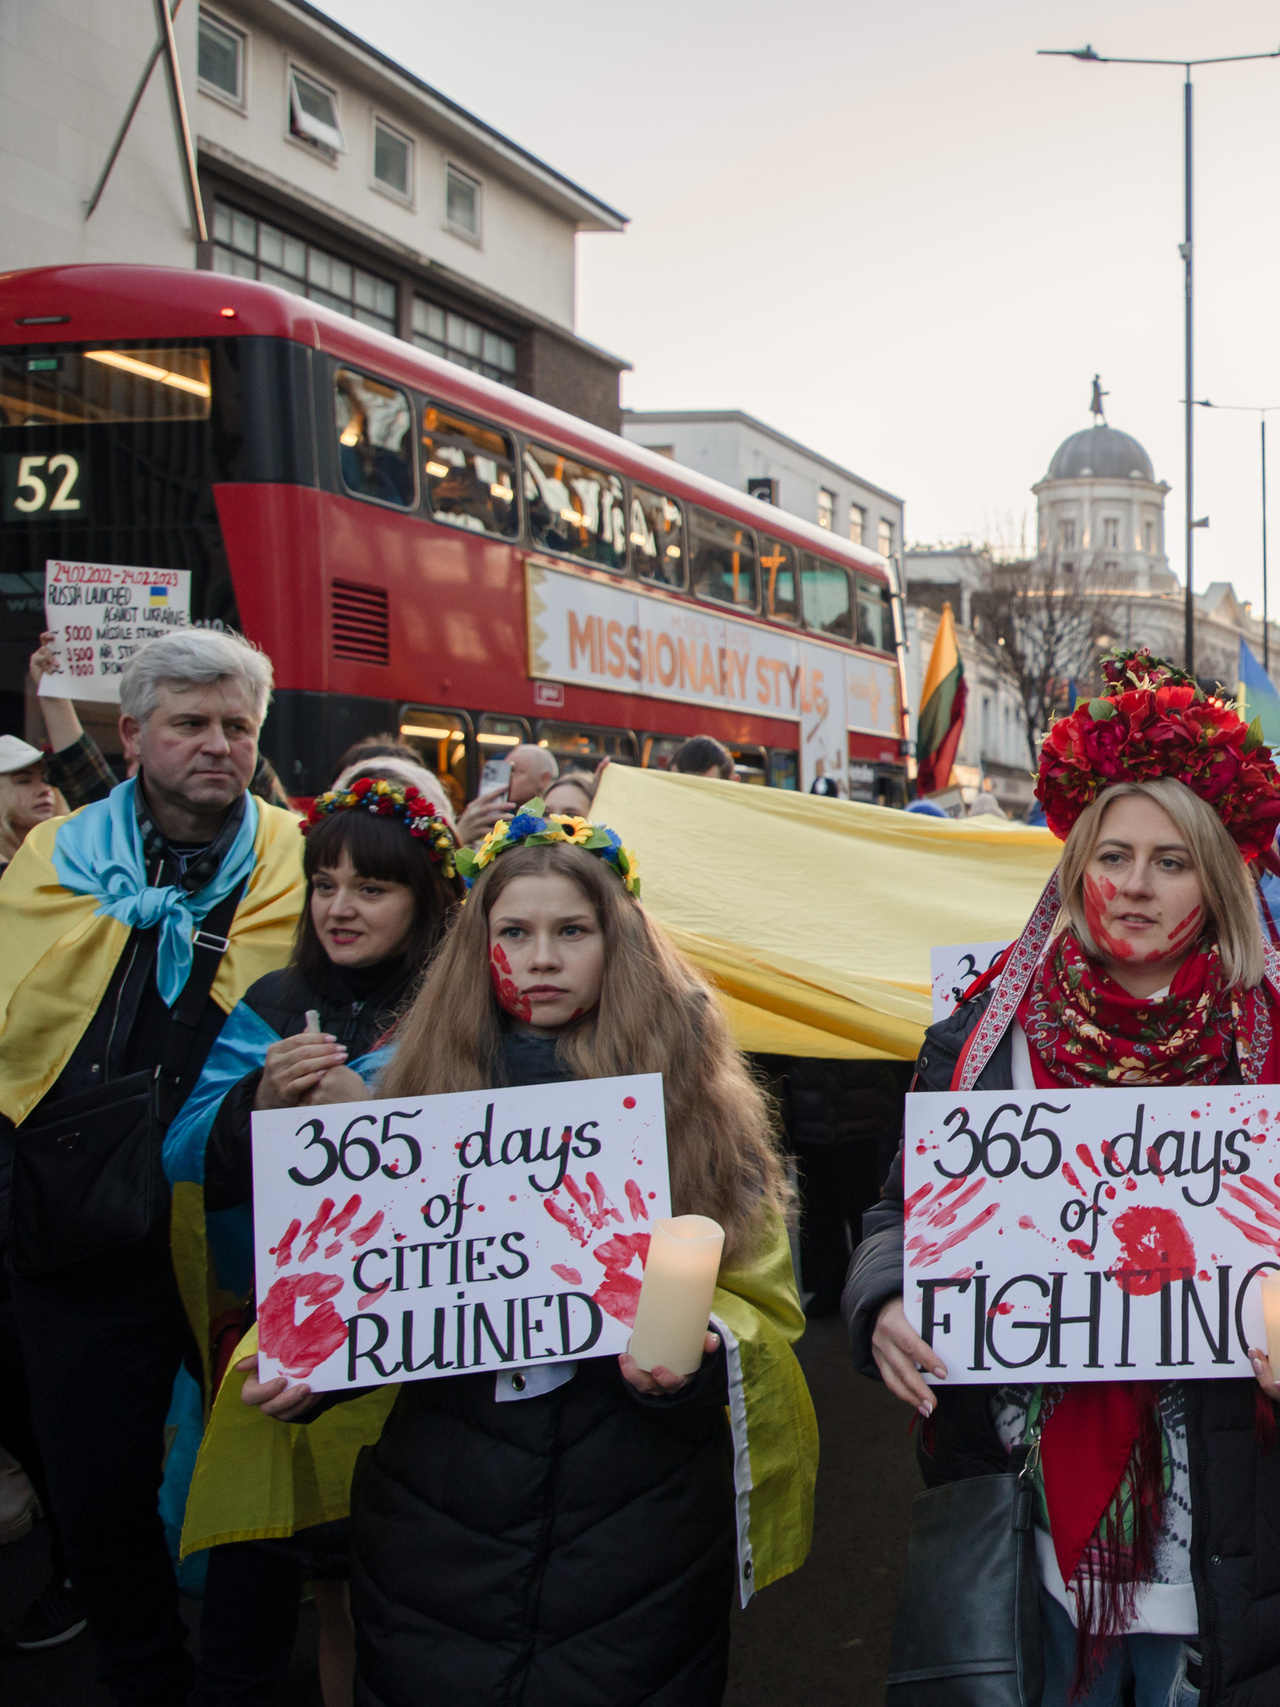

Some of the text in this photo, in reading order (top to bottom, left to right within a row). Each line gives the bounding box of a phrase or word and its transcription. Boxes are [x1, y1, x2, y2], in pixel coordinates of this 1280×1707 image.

[14, 454, 81, 513] 52
[48, 584, 82, 606] RUSSIA
[85, 586, 132, 606] LAUNCHED
[65, 625, 92, 641] 5000
[567, 609, 826, 715] MISSIONARY STYLE
[288, 1103, 602, 1192] 365 days
[933, 1102, 1252, 1207] 365 days
[423, 1173, 475, 1239] of
[1060, 1181, 1109, 1256] of
[353, 1231, 530, 1294] CITIES
[344, 1291, 604, 1382] RUINED
